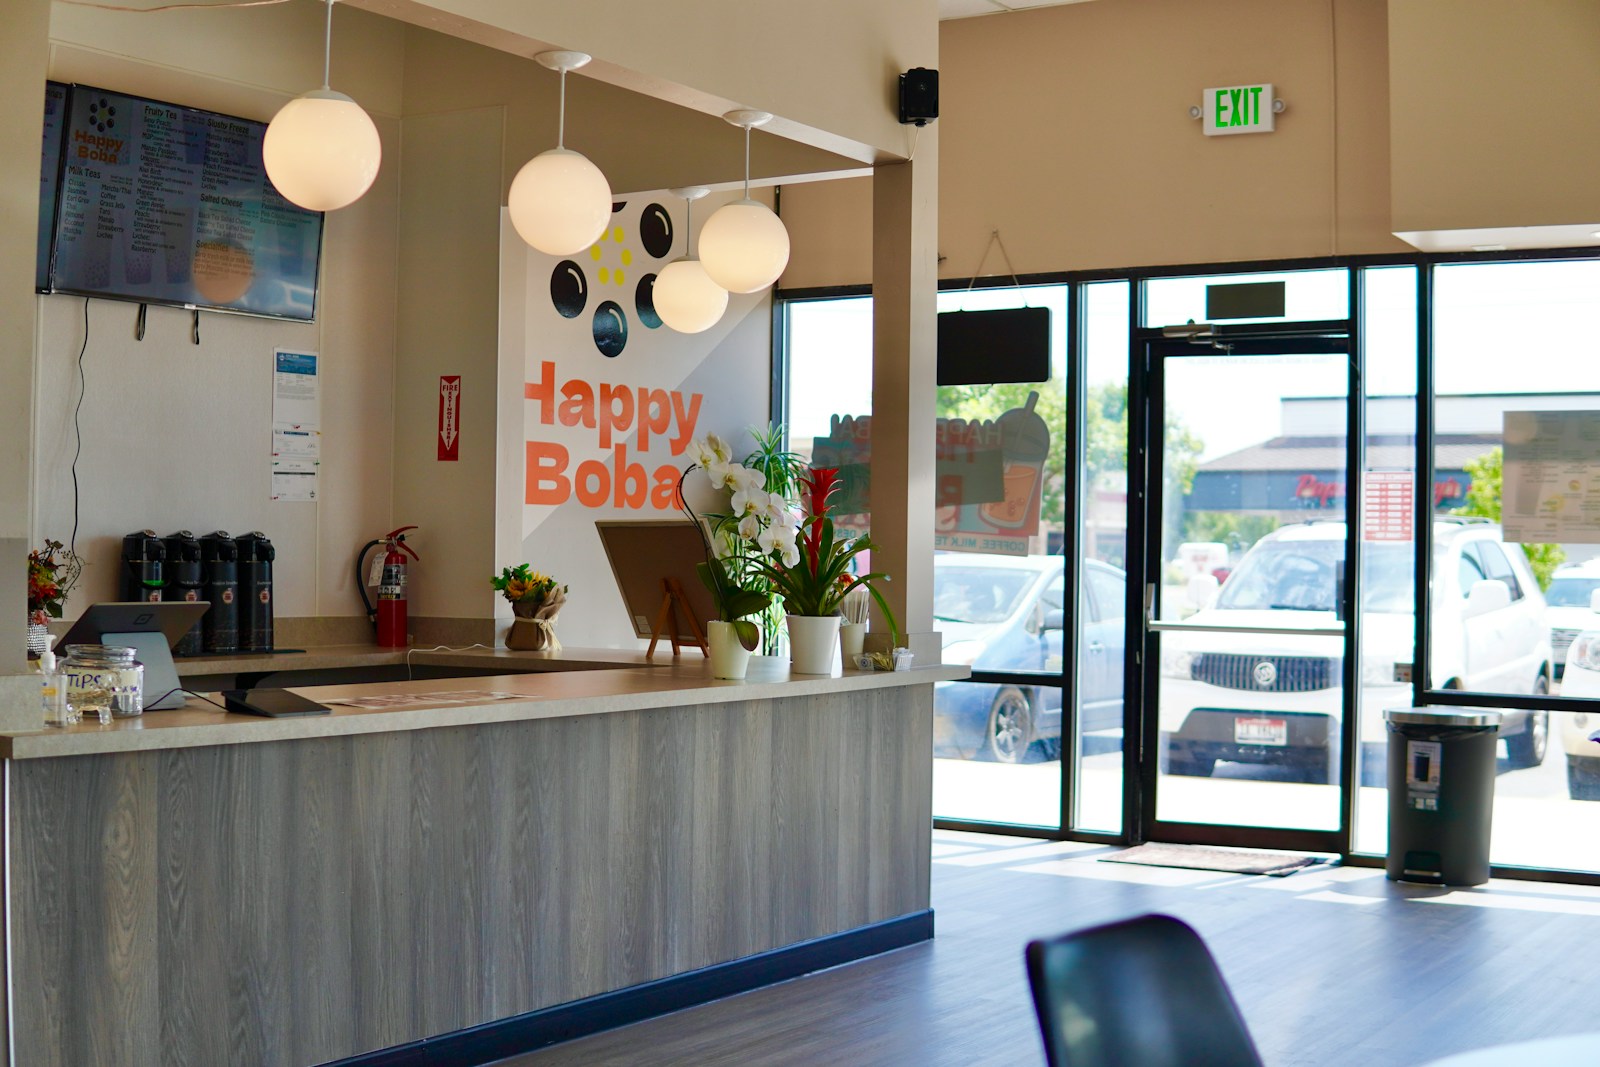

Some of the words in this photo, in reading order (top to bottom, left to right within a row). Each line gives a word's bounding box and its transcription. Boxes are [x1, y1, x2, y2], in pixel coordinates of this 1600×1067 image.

[144, 105, 163, 118] Fruity
[165, 109, 177, 120] Tea
[1216, 87, 1262, 127] EXIT
[229, 122, 249, 134] Freeze
[74, 129, 124, 152] Happy
[77, 145, 118, 165] Boba
[68, 165, 83, 176] Milk
[85, 168, 101, 179] Teas
[200, 193, 220, 204] Salted
[221, 196, 243, 208] Cheese
[525, 440, 685, 511] Boba
